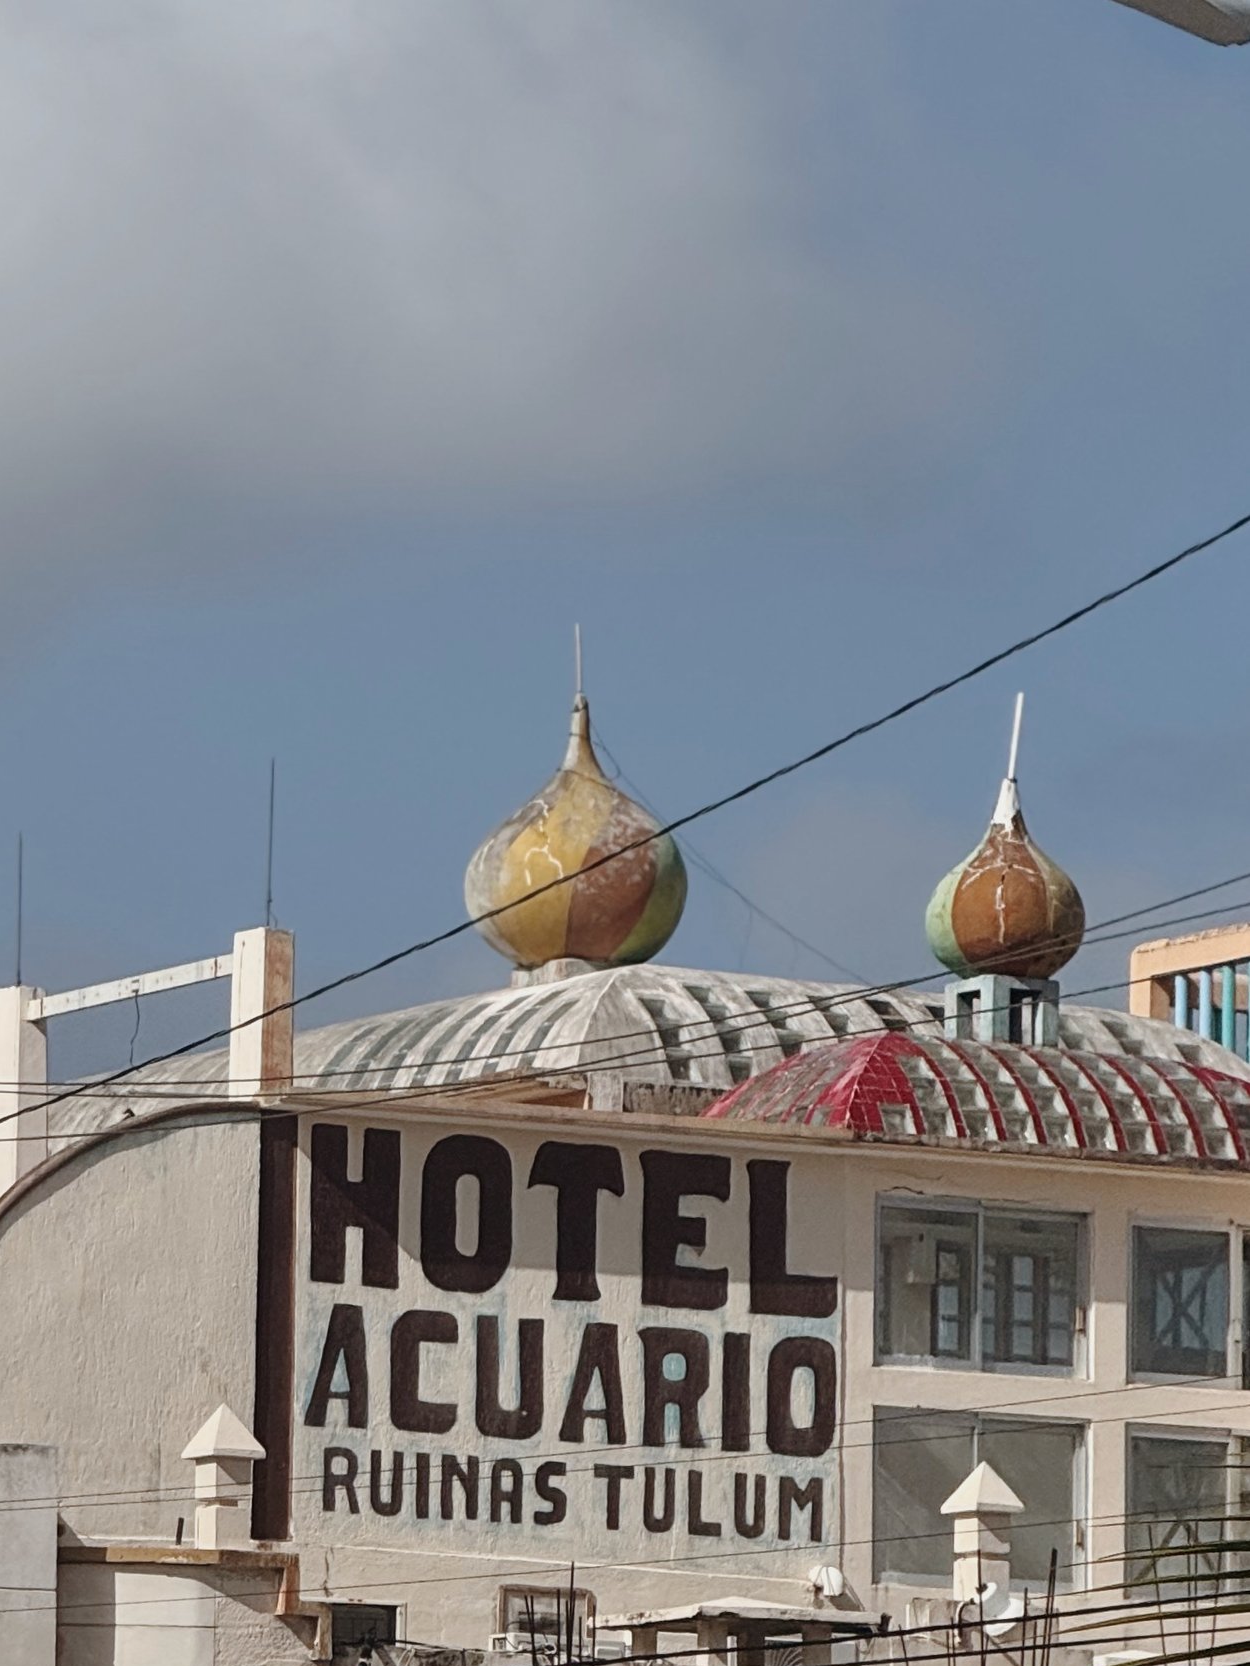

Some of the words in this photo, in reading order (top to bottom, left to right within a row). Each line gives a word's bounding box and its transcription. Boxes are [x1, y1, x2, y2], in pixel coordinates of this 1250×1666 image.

[310, 1123, 839, 1318] HOTEL
[305, 1303, 836, 1458] ACUARIO
[322, 1446, 568, 1526] RUINAS
[593, 1463, 823, 1542] TULUM
